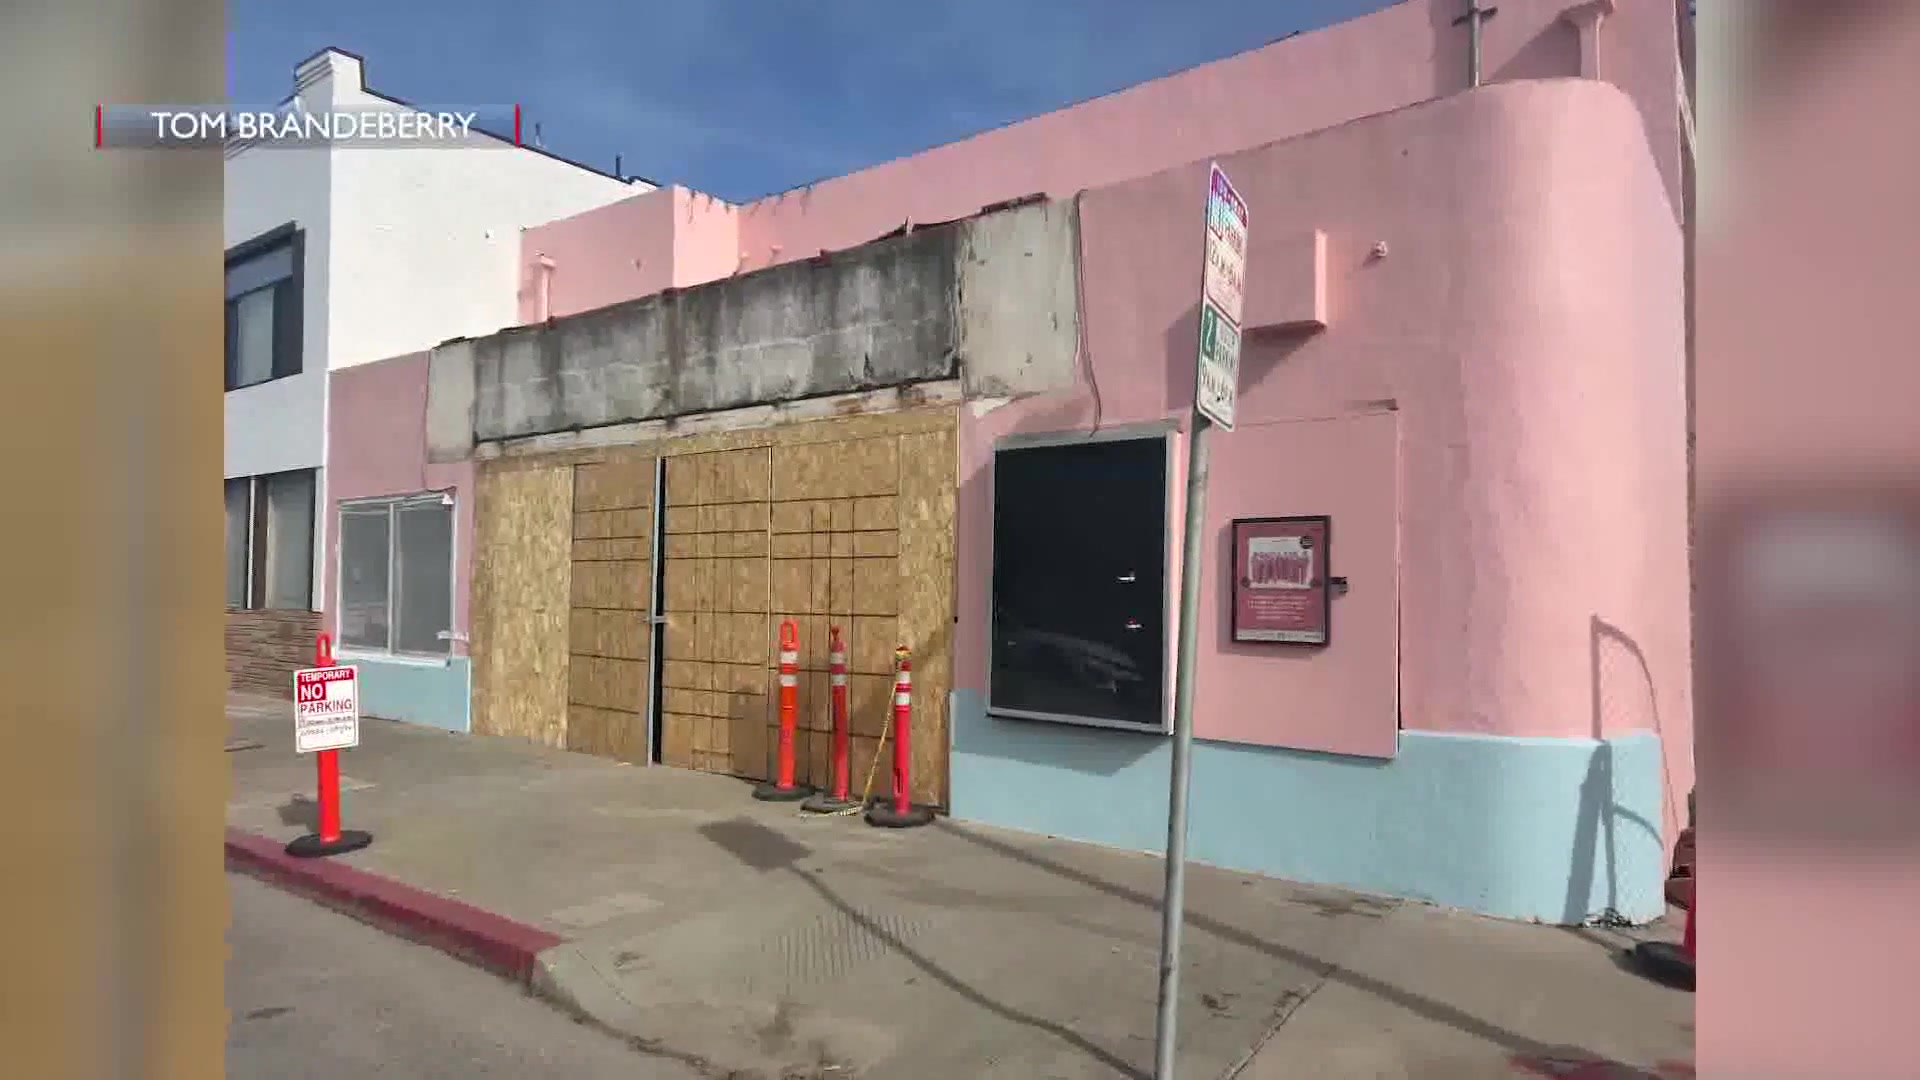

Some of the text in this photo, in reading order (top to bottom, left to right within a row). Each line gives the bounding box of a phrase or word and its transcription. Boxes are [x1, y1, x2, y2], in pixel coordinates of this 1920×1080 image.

[301, 670, 350, 682] TEMPORARY
[301, 683, 324, 700] NO
[300, 699, 352, 713] PARKING
